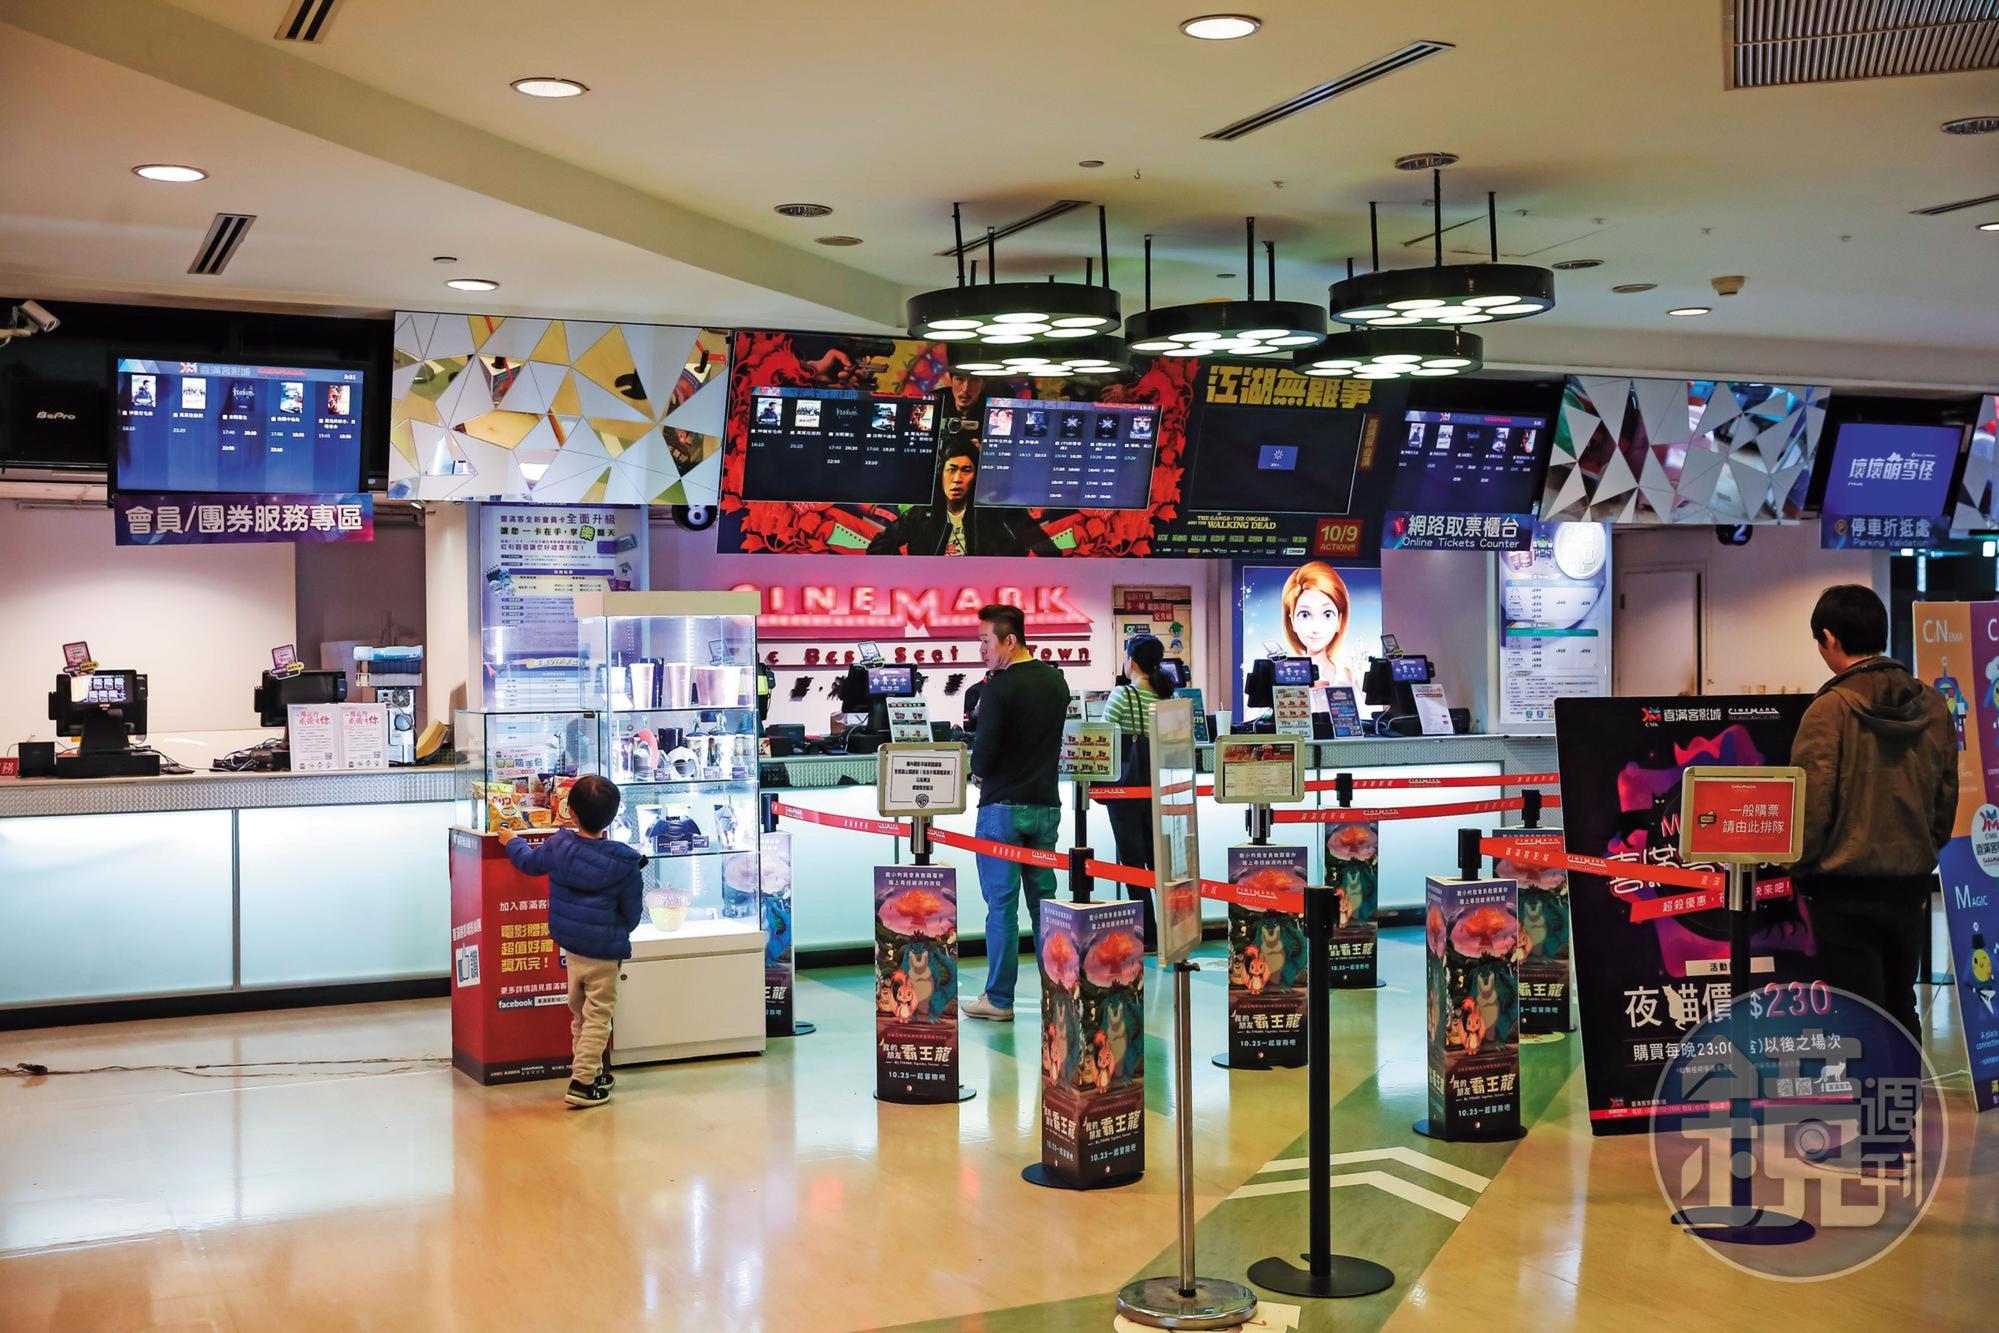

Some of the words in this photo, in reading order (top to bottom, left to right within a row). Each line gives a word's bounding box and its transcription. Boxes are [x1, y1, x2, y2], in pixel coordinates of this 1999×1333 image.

[37, 410, 75, 421] BePro
[1848, 453, 1936, 481] 壞壞萌雪怪
[125, 503, 363, 535] 會員/團券服務專區
[1208, 521, 1249, 530] WALKING
[1251, 522, 1276, 530] DEAD
[1407, 515, 1519, 538] 網路取票櫃台
[1320, 525, 1359, 541] 10/9
[1851, 518, 1930, 538] 停車折抵處
[1402, 537, 1437, 547] Online
[1439, 538, 1475, 548] Tickets
[1480, 538, 1520, 548] Counter
[1853, 538, 1885, 548] Parking
[1889, 538, 1929, 548] Validation
[729, 583, 1094, 632] INEMARK
[1663, 708, 1722, 722] 喜滿客影城
[1728, 707, 1780, 715] CINEMARK
[1730, 804, 1779, 817] 一般購票
[1722, 820, 1785, 834] 請由此排隊
[1567, 855, 1607, 867] CINEMARK
[1236, 886, 1278, 899] CINEMARK
[1955, 884, 1988, 910] MAGIC
[500, 899, 550, 912] 加入喜滿客
[501, 939, 554, 956] 超值好禮
[498, 998, 533, 1009] facebook
[1750, 979, 1832, 1019] $230
[1252, 1013, 1303, 1029] 霸王龍
[901, 1044, 953, 1063] 霸王龍
[1470, 1073, 1517, 1095] 霸王龍
[1101, 1110, 1142, 1136] 霸王龍
